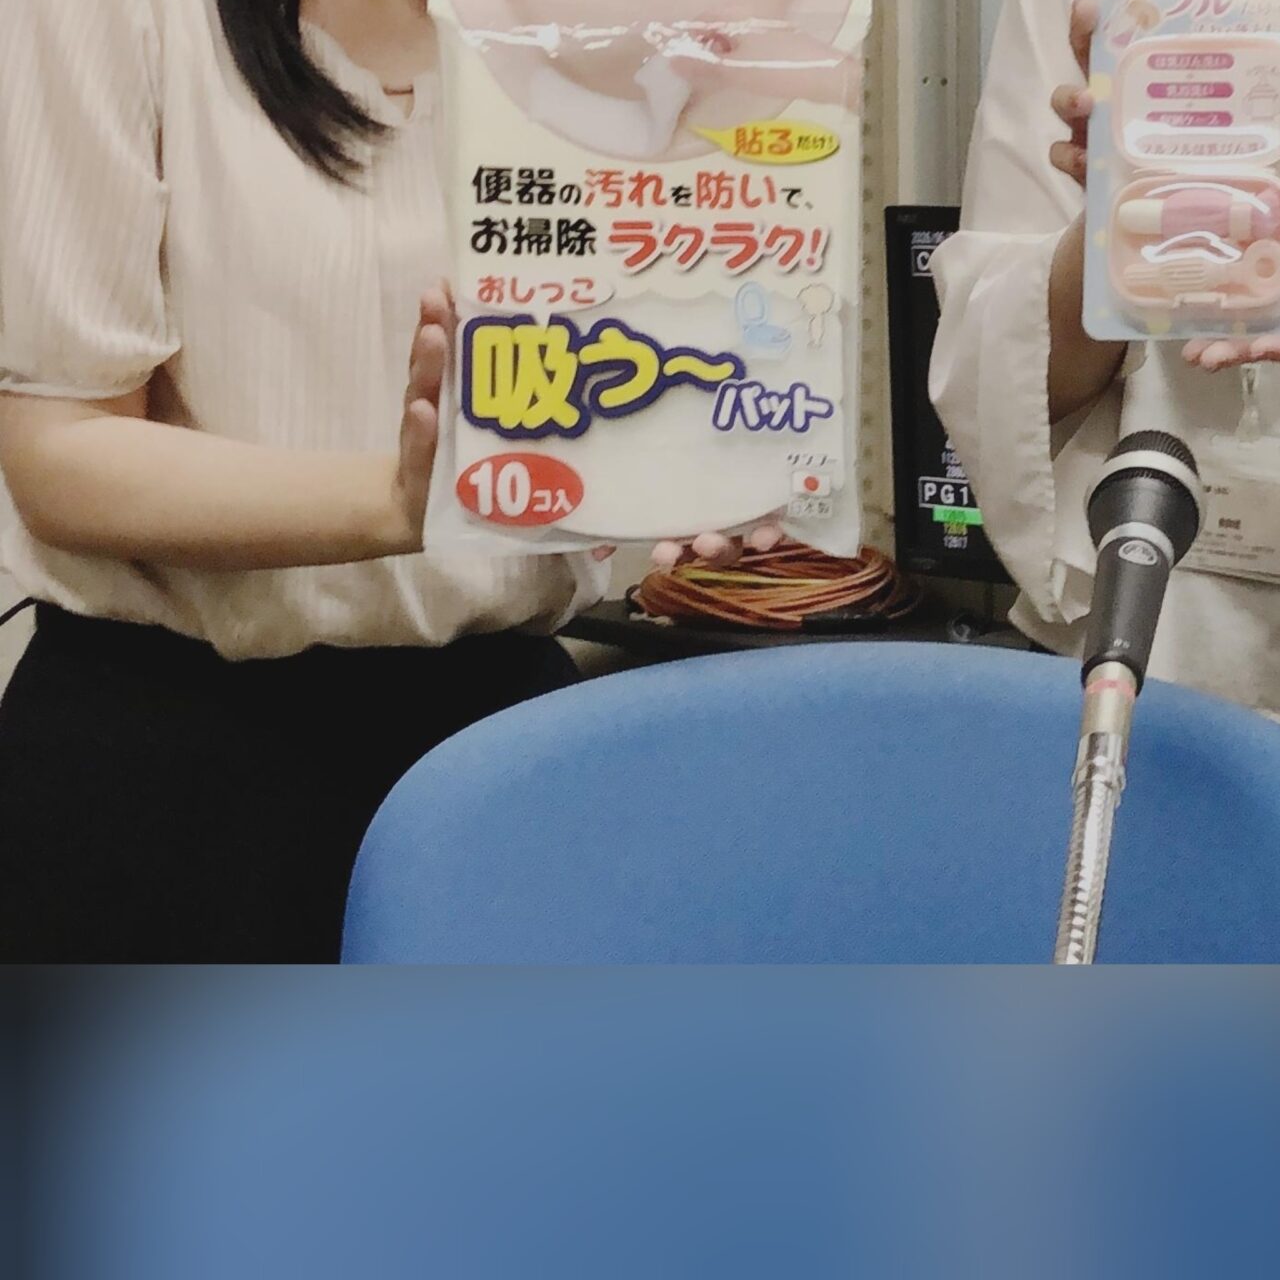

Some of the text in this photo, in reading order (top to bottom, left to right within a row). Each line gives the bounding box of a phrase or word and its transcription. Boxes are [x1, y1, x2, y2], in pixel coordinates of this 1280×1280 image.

[477, 276, 597, 305] おしっこ
[468, 461, 574, 518] 10コ入
